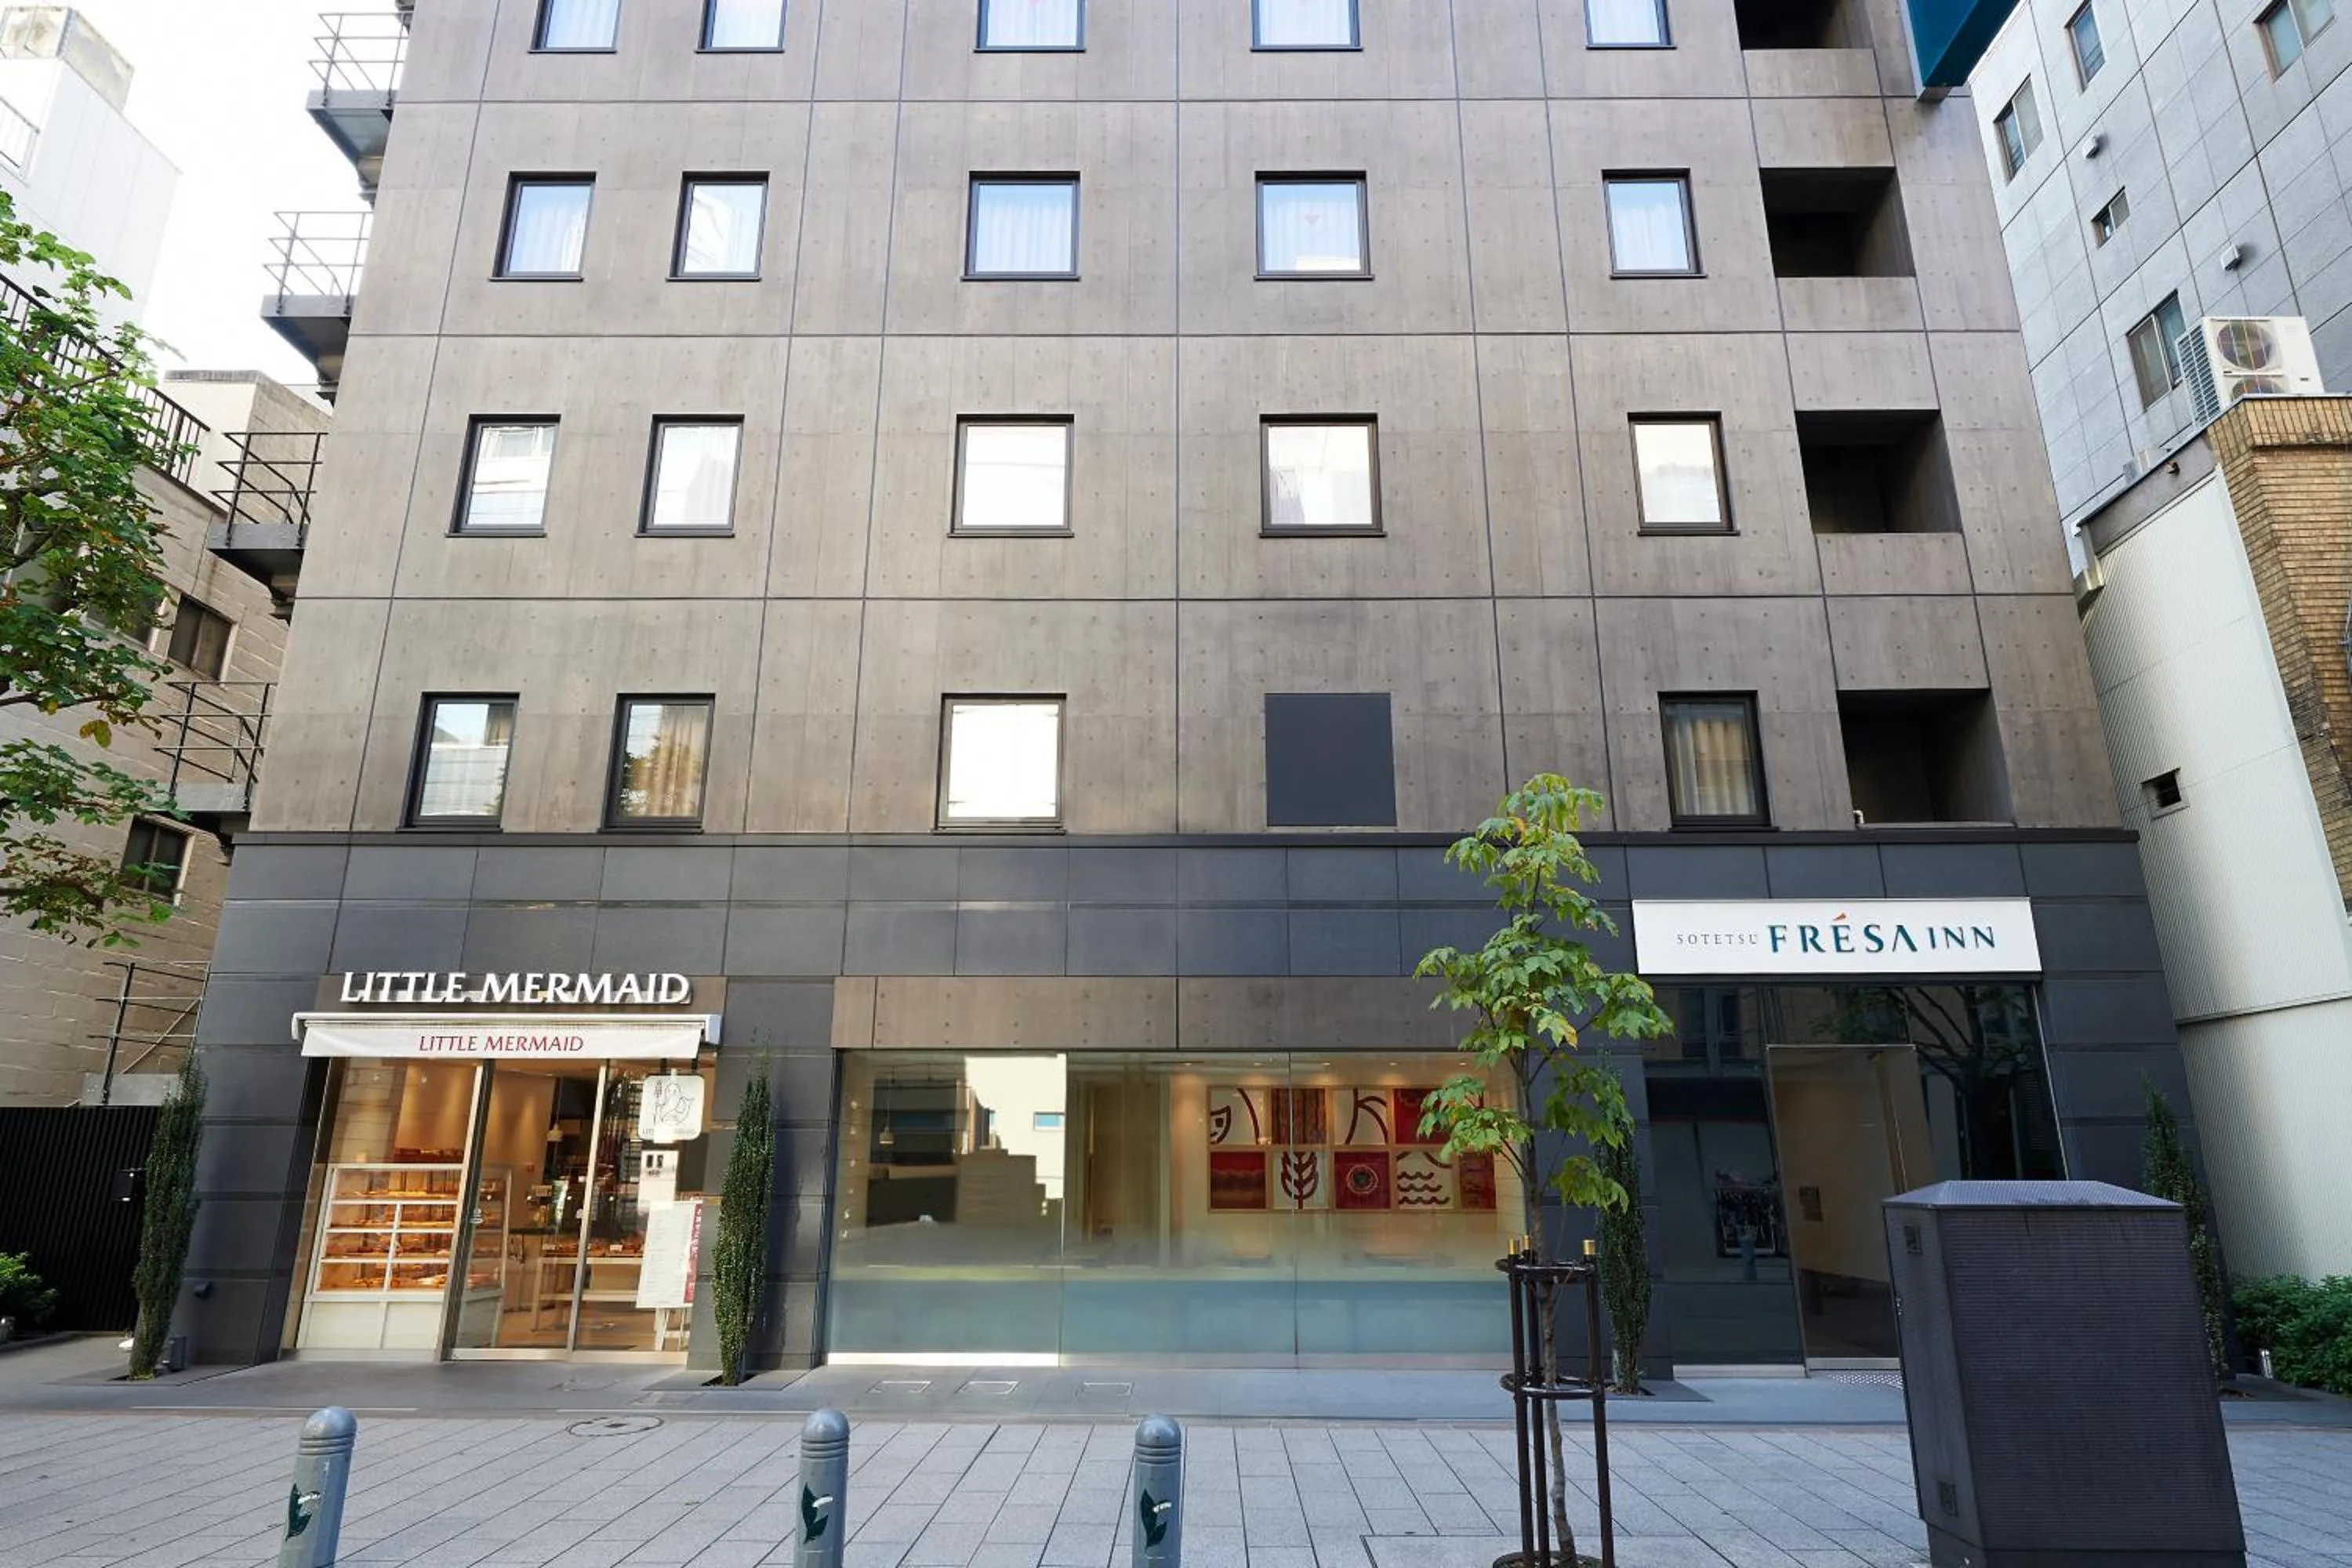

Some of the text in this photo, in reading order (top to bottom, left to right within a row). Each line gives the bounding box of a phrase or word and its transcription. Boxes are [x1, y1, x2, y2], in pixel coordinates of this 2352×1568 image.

[1676, 933, 1758, 945] SOTETSU
[1928, 926, 1995, 949] INN
[339, 971, 691, 1004] LITTLE MERMAID
[419, 1036, 583, 1051] LITTLE MERMAID
